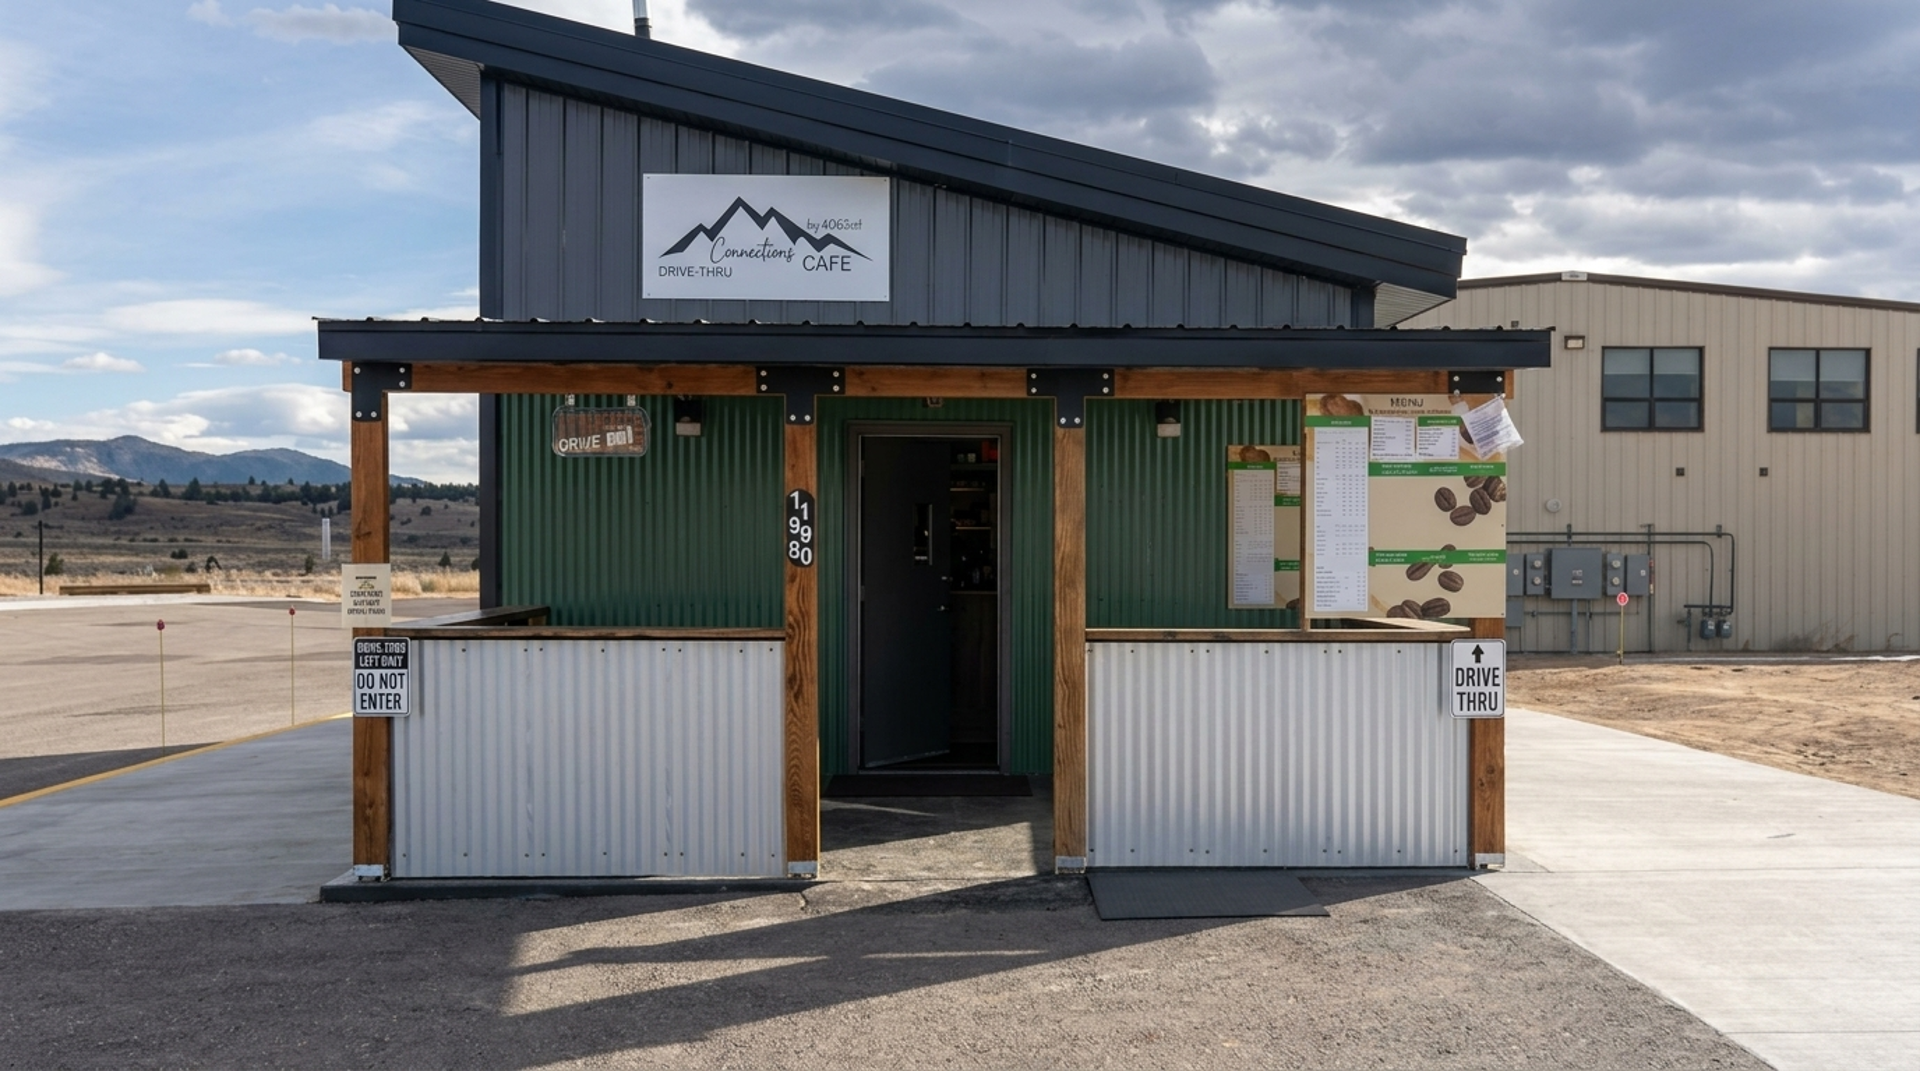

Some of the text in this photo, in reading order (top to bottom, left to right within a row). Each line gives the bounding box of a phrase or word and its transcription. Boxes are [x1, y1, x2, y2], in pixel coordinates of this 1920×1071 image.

[710, 236, 795, 264] Connections
[802, 254, 851, 271] CAFE
[658, 266, 733, 278] DRIVE-THRU
[379, 672, 406, 690] NOT
[1455, 667, 1500, 687] DRIVE
[360, 692, 402, 710] ENTER
[1456, 691, 1498, 712] THRU
